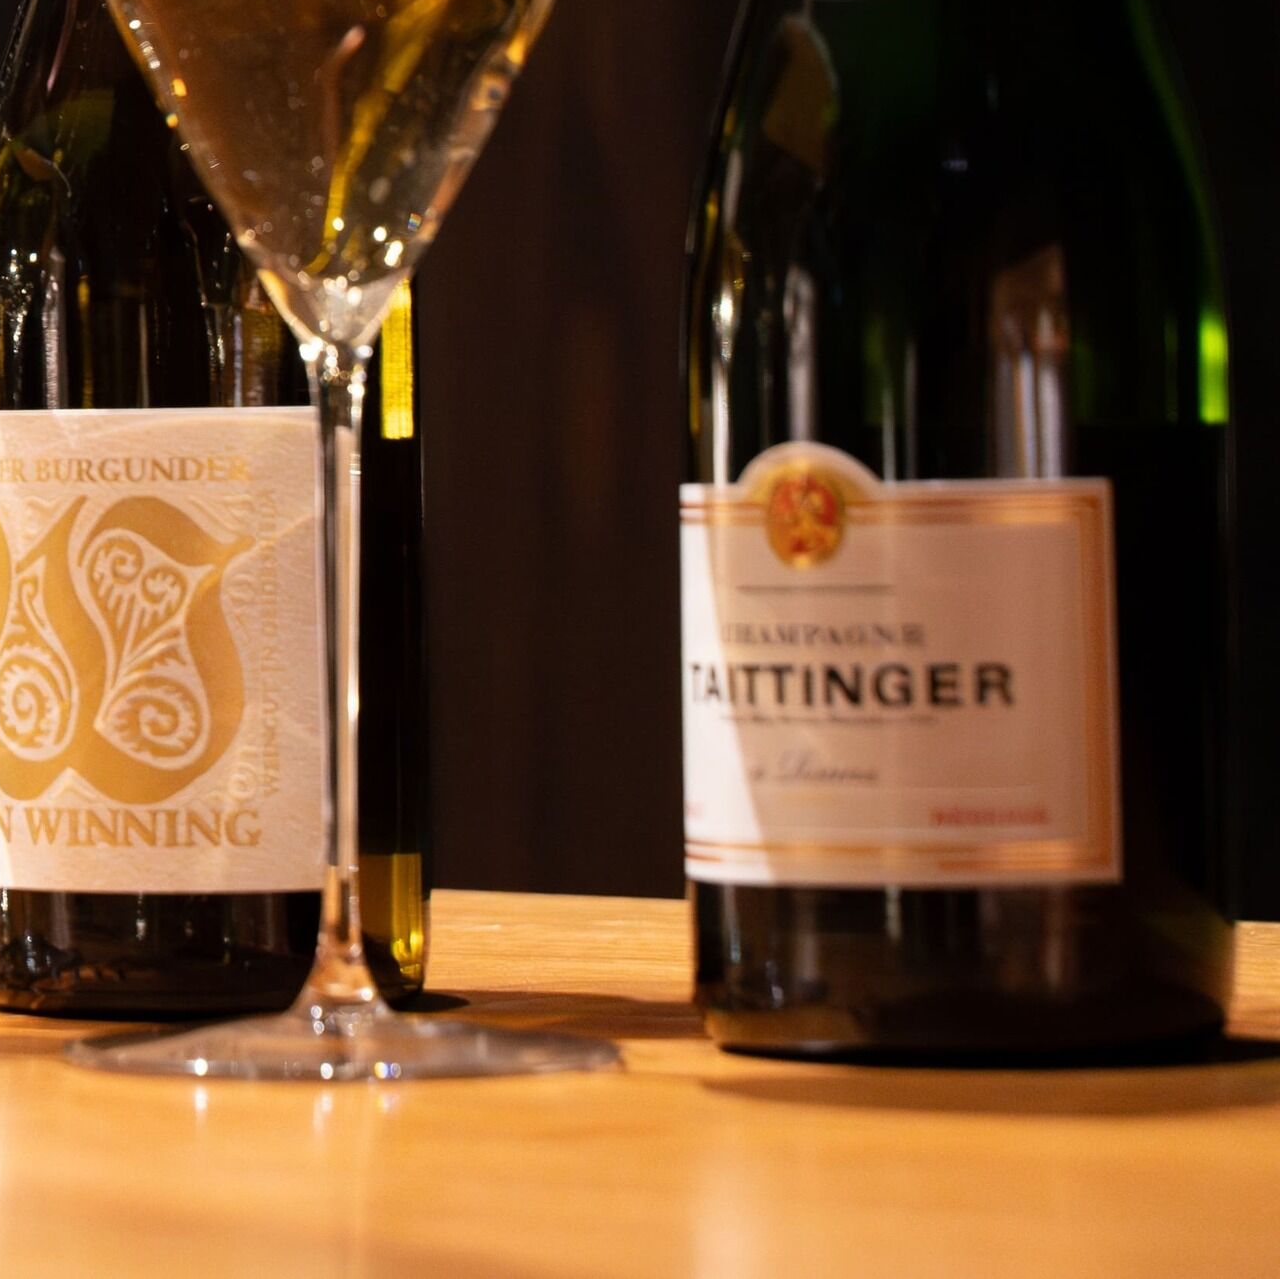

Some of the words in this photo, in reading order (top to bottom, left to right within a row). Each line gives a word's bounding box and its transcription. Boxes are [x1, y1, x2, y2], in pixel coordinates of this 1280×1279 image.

[34, 456, 252, 483] BURGUNDER
[690, 661, 1015, 707] TAITTINGER
[23, 806, 263, 849] WINNING
